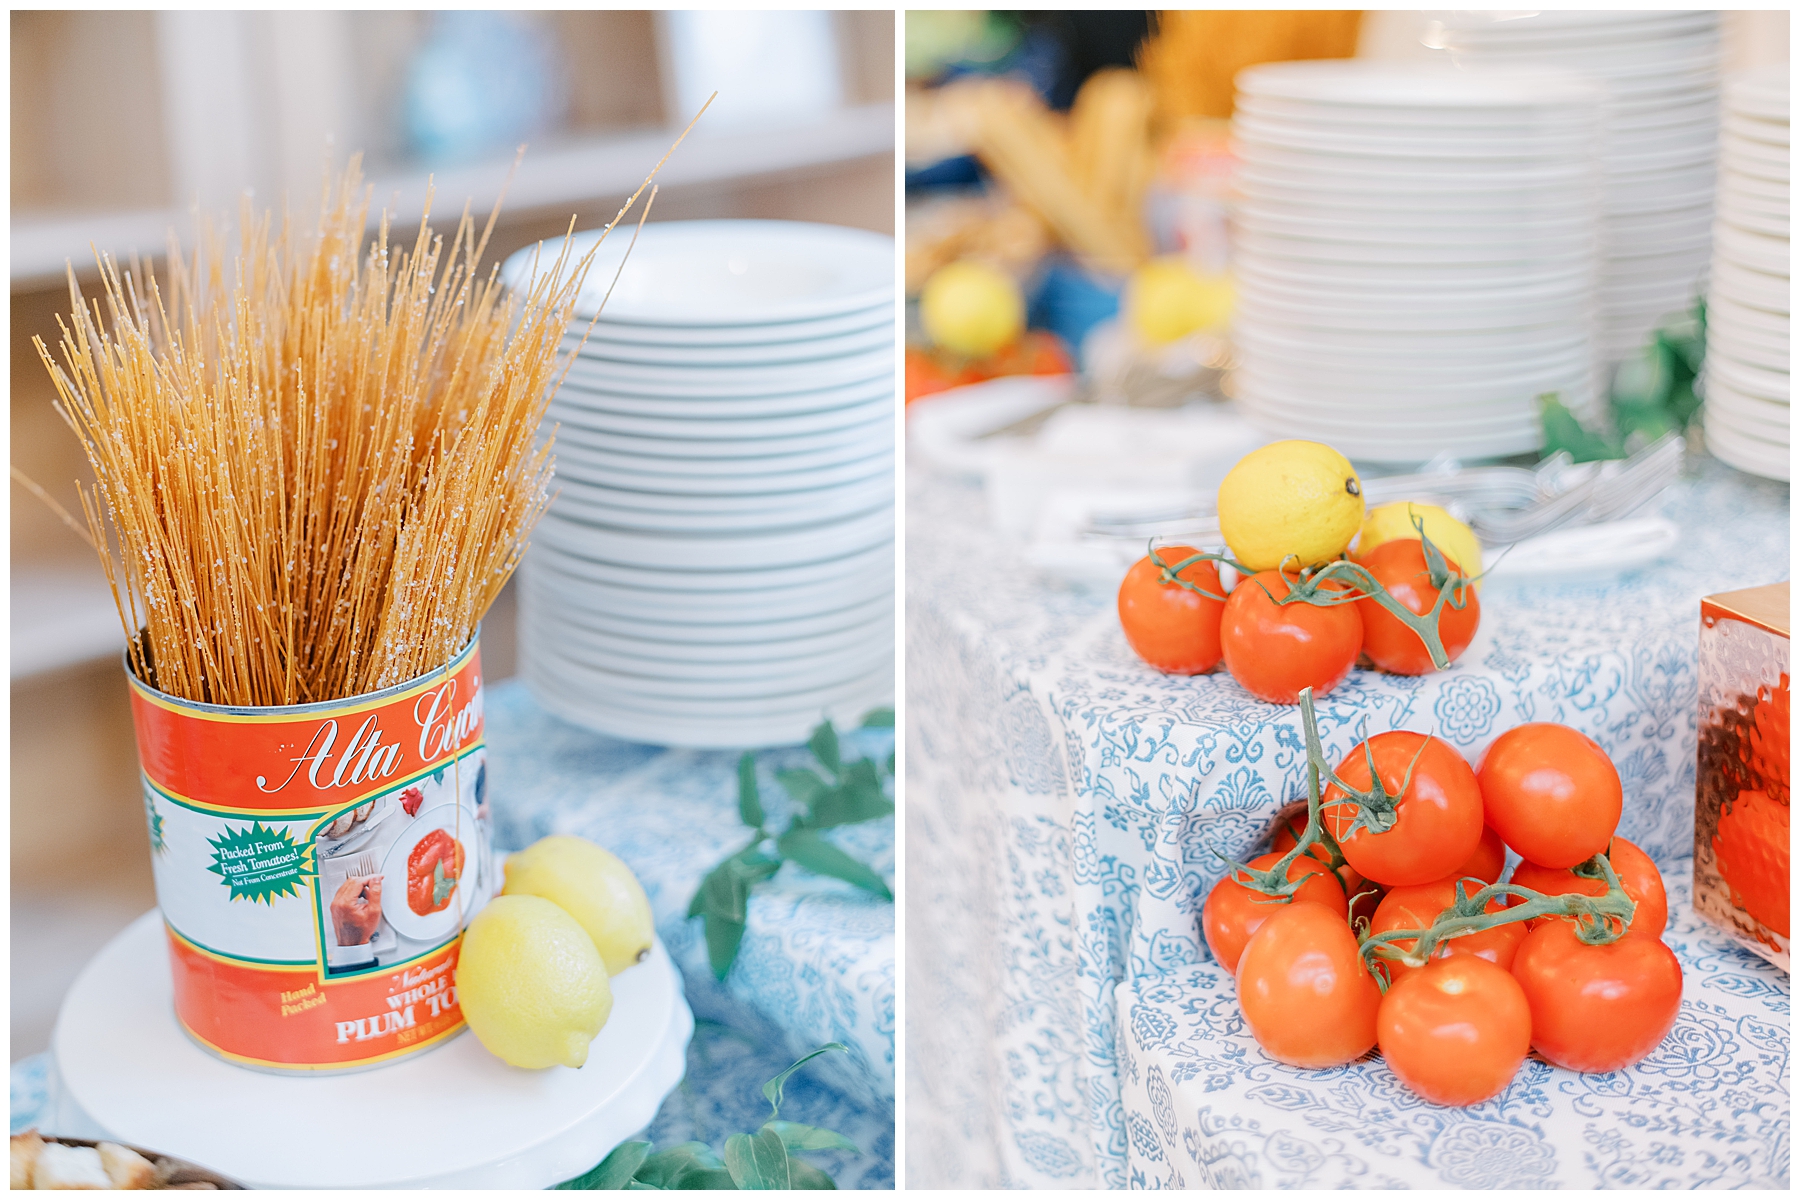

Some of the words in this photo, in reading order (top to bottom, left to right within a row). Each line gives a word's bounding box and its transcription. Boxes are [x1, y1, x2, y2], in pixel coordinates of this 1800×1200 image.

[256, 714, 404, 793] Alta
[414, 676, 483, 762] Cuci
[219, 843, 255, 860] Packed
[255, 841, 285, 854] From
[220, 861, 247, 874] Fresh
[247, 848, 300, 870] Tomatoes!
[232, 878, 244, 887] Not
[244, 876, 261, 886] From
[260, 868, 298, 882] Concentrate
[280, 982, 316, 1004] Hand
[386, 974, 448, 1009] WHOLE
[281, 992, 327, 1017] Packed
[335, 1005, 417, 1044] PLUM
[425, 985, 459, 1017] TO
